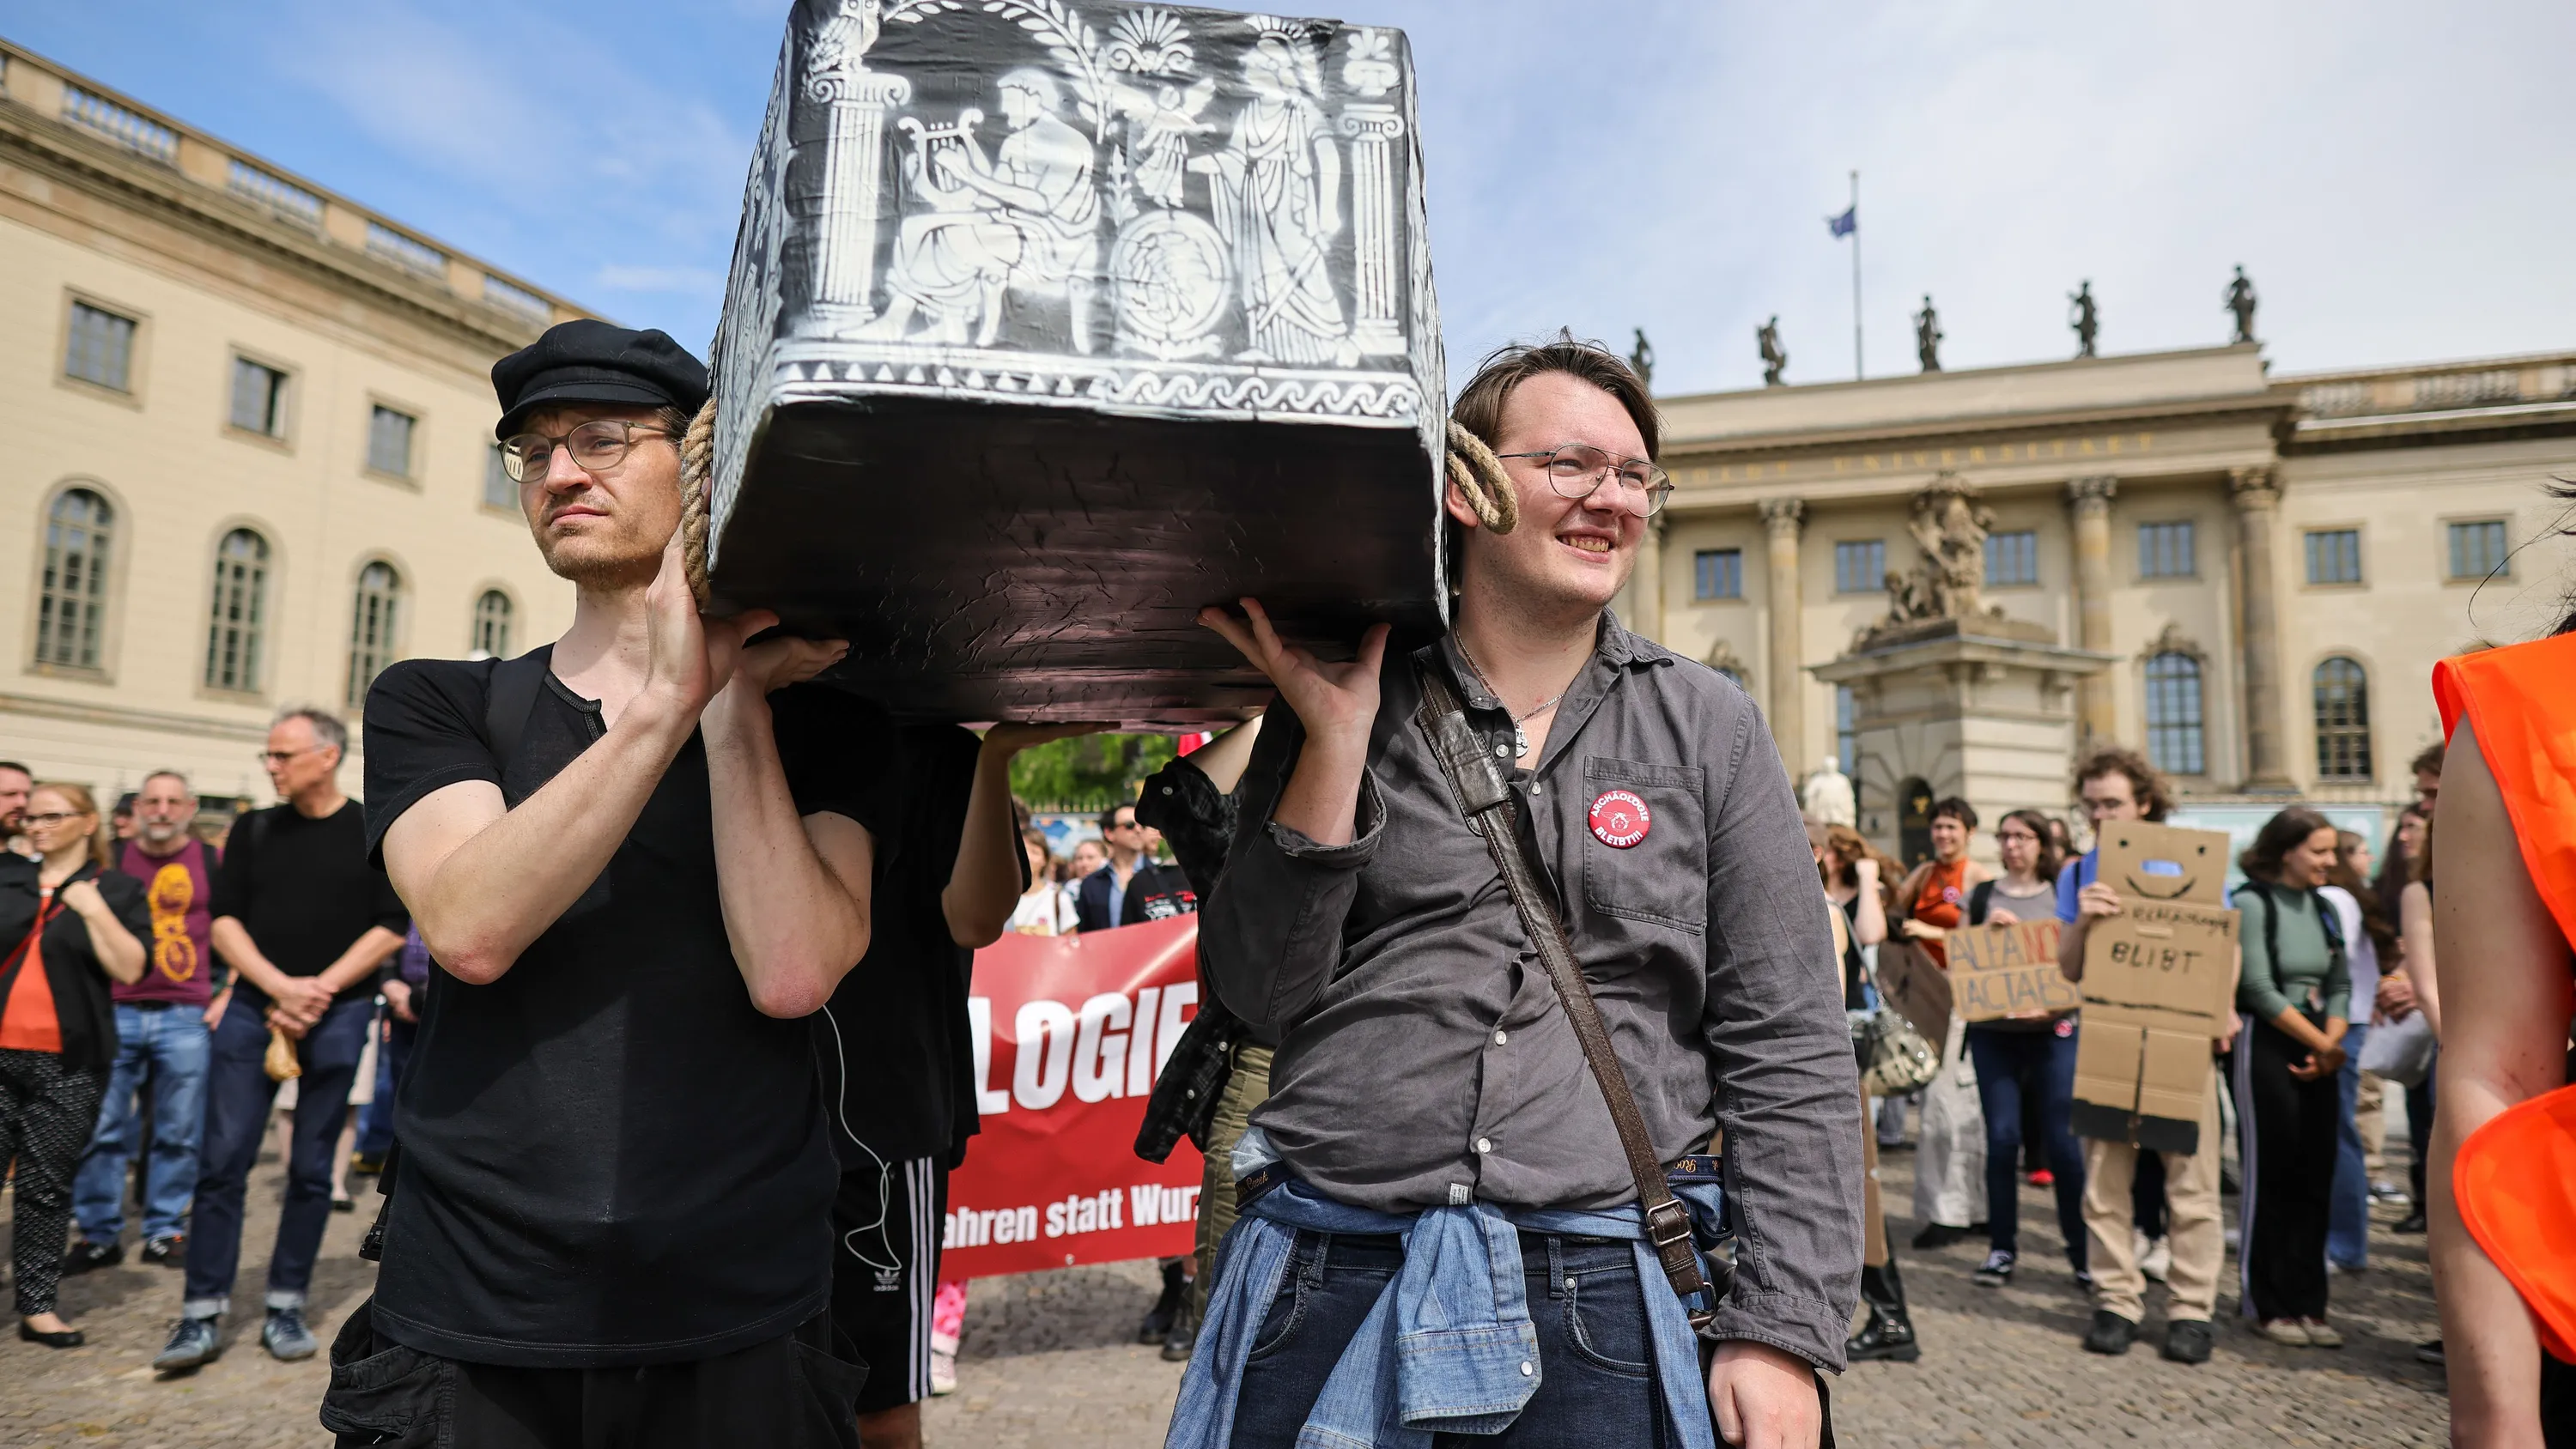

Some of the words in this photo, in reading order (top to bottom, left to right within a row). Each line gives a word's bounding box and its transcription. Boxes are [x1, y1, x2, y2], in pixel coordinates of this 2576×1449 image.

[1590, 790, 1649, 822] ARCHÄOLOGIE
[1595, 826, 1643, 846] BLEIBT!!!
[2111, 941, 2204, 974] BLIBT
[1045, 1191, 1124, 1238] statt
